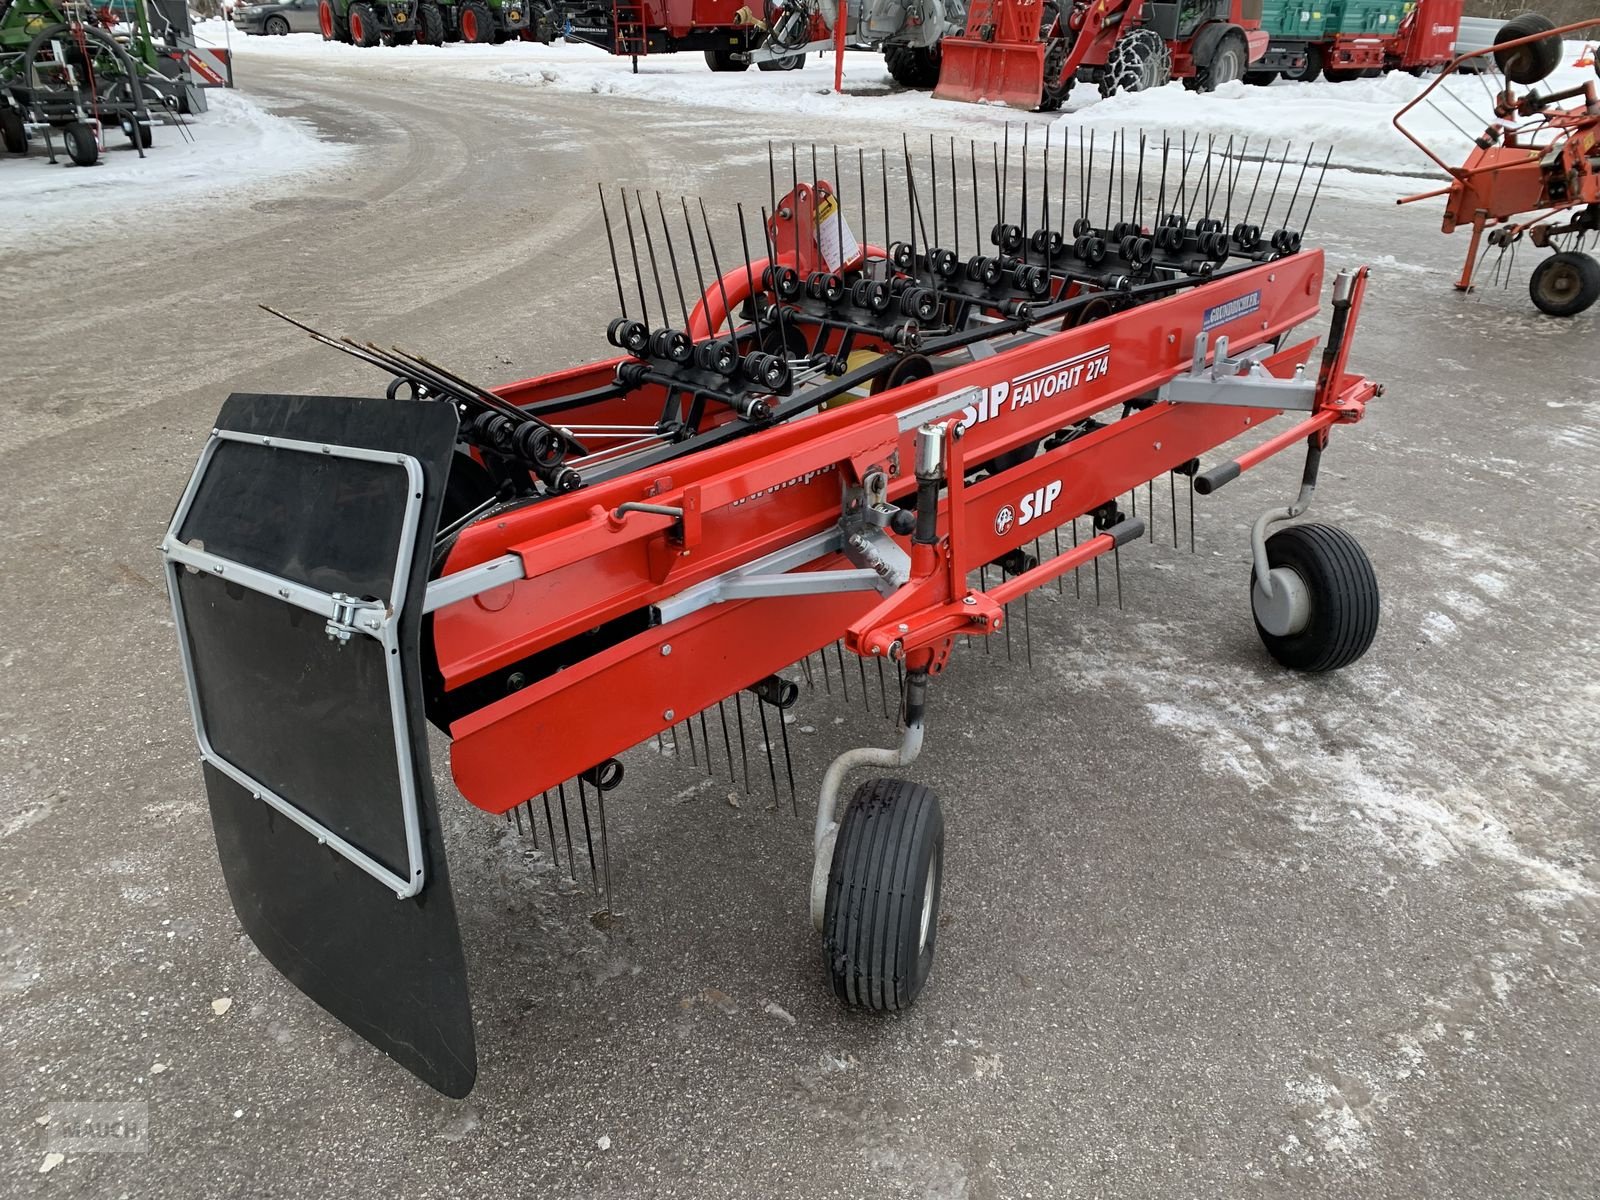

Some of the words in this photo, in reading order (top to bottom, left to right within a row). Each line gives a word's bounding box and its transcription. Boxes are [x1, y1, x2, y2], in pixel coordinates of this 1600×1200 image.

[1011, 364, 1085, 411] FAVORIT
[1085, 355, 1109, 382] 274
[1018, 479, 1063, 526] SIP
